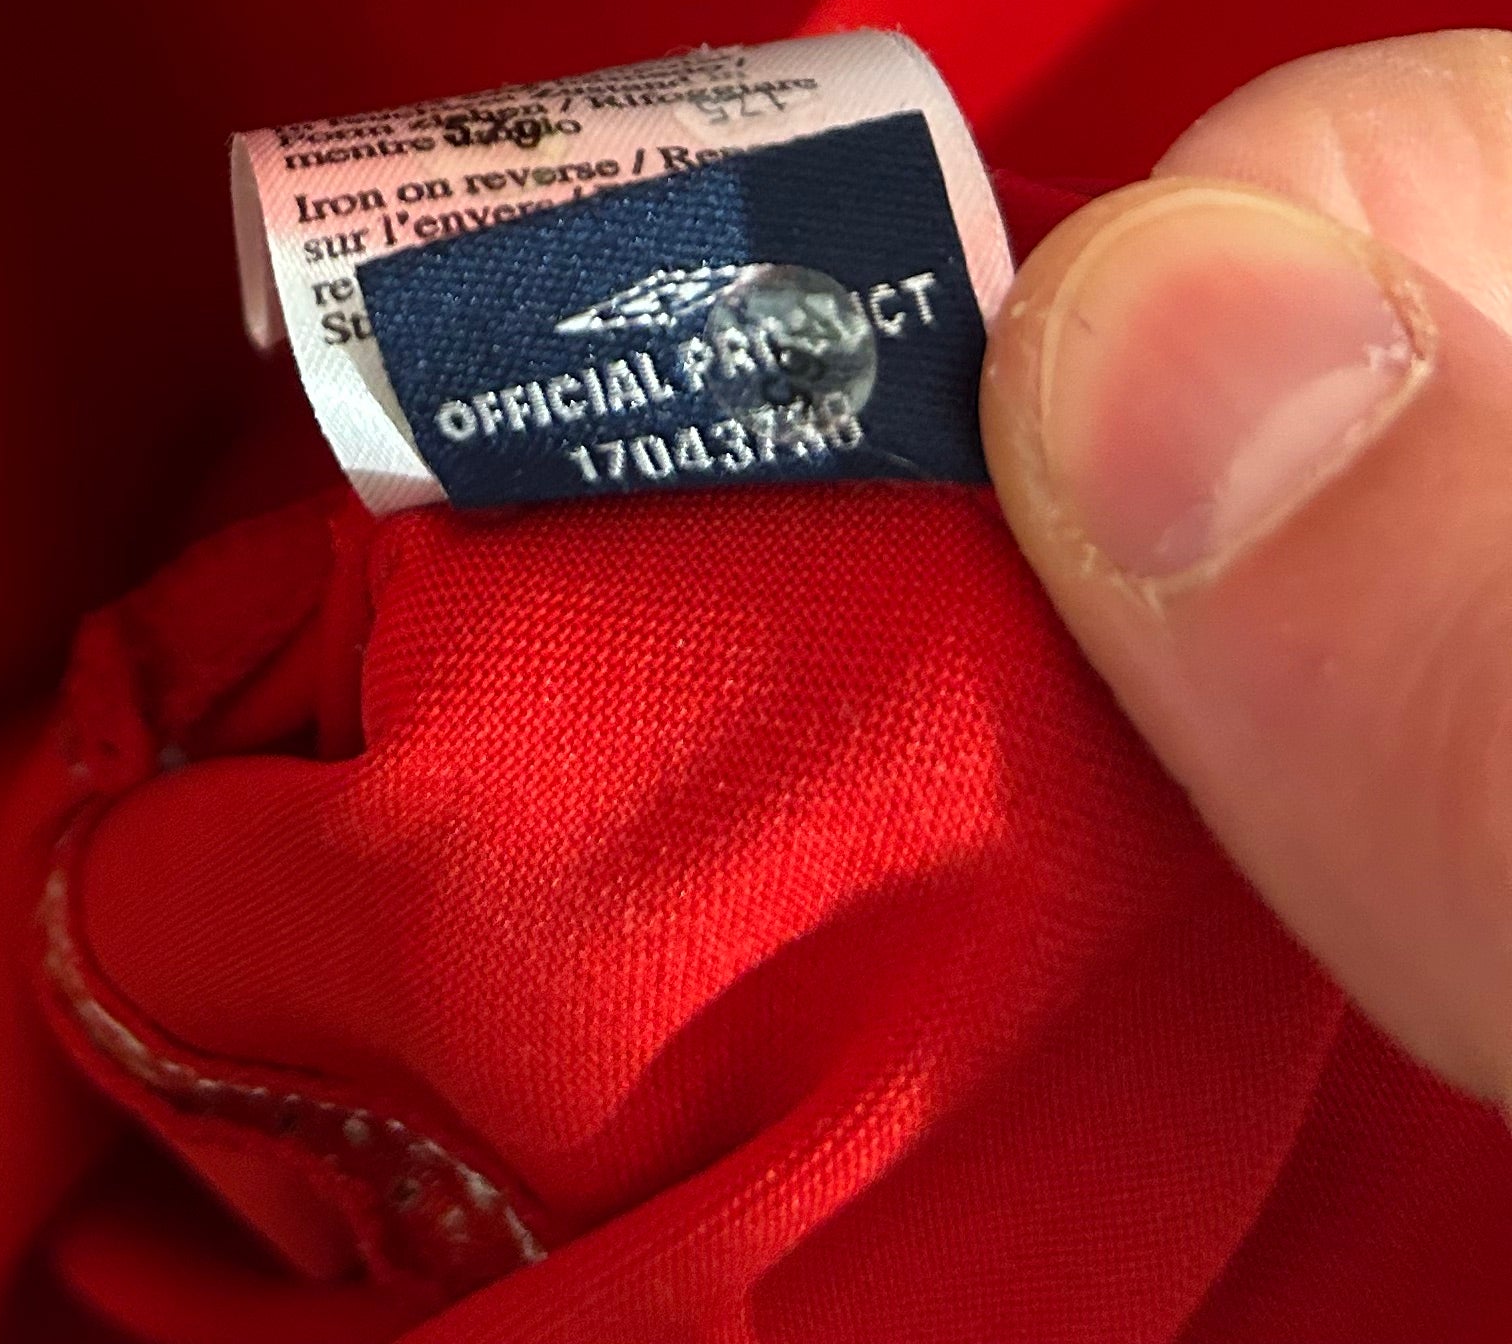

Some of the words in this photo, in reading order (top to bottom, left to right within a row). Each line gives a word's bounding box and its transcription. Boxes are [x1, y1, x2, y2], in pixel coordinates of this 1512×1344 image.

[284, 136, 436, 170] mentre
[293, 187, 387, 224] Iron
[396, 177, 453, 203] on
[464, 159, 619, 195] reverse
[632, 147, 645, 174] /
[303, 227, 369, 263] sur
[434, 351, 675, 442] OFFICIAL
